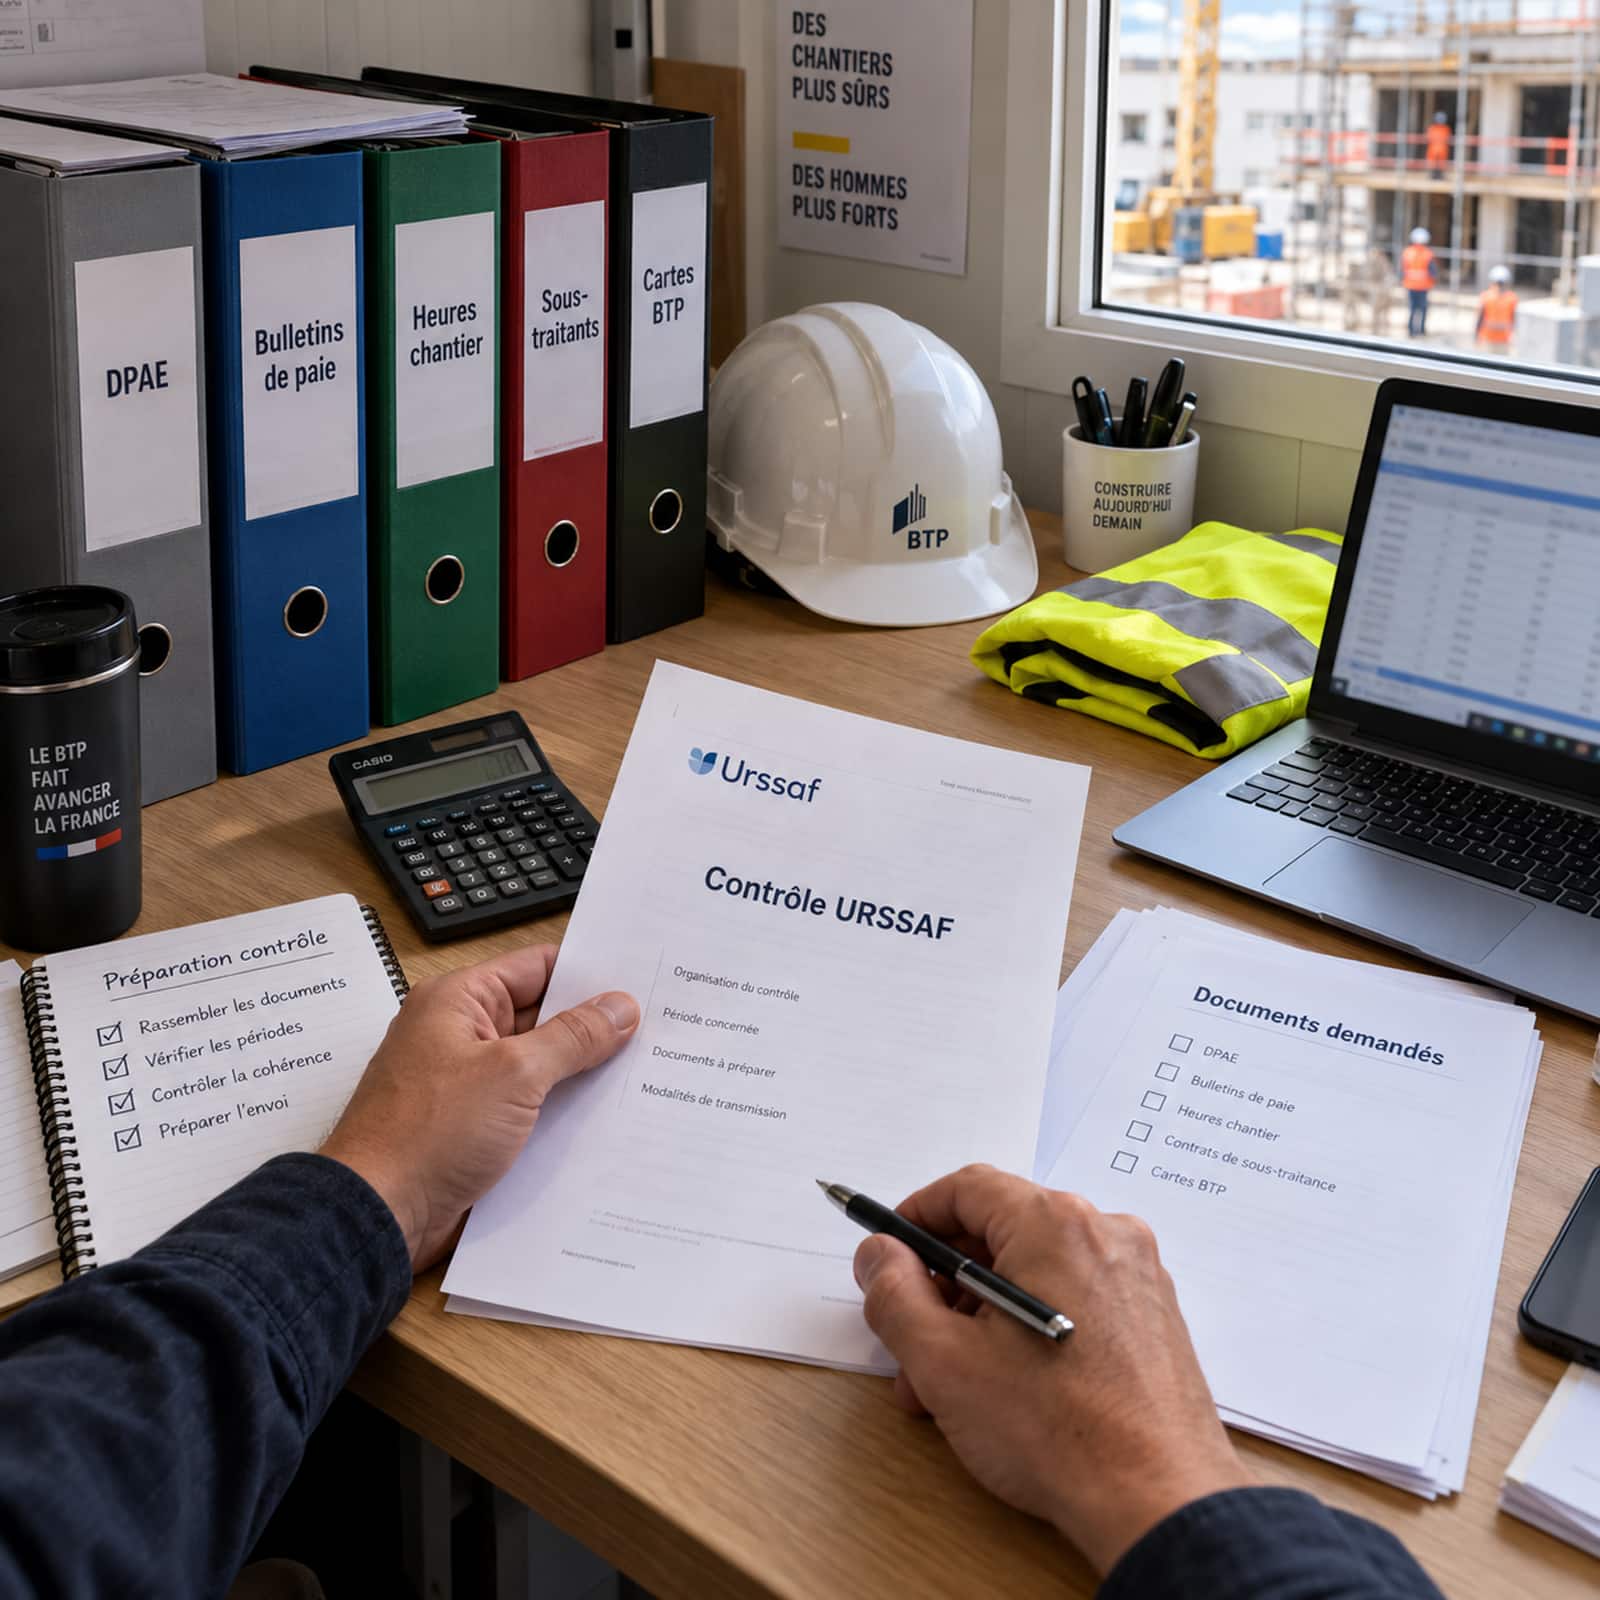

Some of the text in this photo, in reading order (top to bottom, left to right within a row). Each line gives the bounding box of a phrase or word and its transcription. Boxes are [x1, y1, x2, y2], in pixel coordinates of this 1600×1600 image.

[793, 11, 826, 36] DES
[793, 44, 893, 77] CHANTIERS
[793, 77, 889, 109] PLUS SÛRS
[793, 164, 907, 199] DES HOMMES
[793, 196, 898, 230] PLUS FORTS
[643, 264, 694, 291] Cartes
[413, 301, 477, 329] Heures
[542, 287, 588, 312] Sous-
[652, 298, 684, 324] BTP
[255, 319, 344, 356] Bulletins
[532, 315, 599, 348] traitants
[410, 332, 483, 365] chantier
[107, 360, 168, 397] DPAE
[265, 357, 336, 392] de paie
[1094, 498, 1171, 512] AUJOURD'HUI
[1095, 482, 1171, 497] CONSTRUIRE
[1093, 514, 1141, 530] DEMAIN
[908, 529, 949, 549] BTP
[30, 741, 87, 764] LE BTP
[352, 754, 392, 770] CASIO
[32, 768, 69, 787] FAIT
[721, 756, 821, 802] Urssaf
[34, 782, 111, 811] AVANCER
[35, 800, 120, 834] LA FRANCE
[704, 866, 954, 940] Contrôle URSSAF
[103, 930, 328, 991] Préparation contrôle
[674, 966, 800, 1002] Organisation du contrôle
[139, 976, 347, 1034] Rassembler les documents
[663, 1008, 759, 1035] Période concernée
[1193, 986, 1445, 1066] Documents demandés
[145, 1020, 303, 1068] Vérifier les périodes
[1203, 1046, 1239, 1064] DPAE
[152, 1050, 333, 1103] Contrôler la cohérence
[652, 1046, 776, 1078] Documents à préparer
[641, 1083, 787, 1120] Modalités de transmission
[1191, 1075, 1296, 1113] Bulletins de paie
[159, 1095, 289, 1139] Préparer l'envoi
[1177, 1104, 1280, 1143] Heures chantier
[1164, 1134, 1337, 1193] Contrats de sous-traitance
[1151, 1166, 1226, 1196] Cartes BTP
